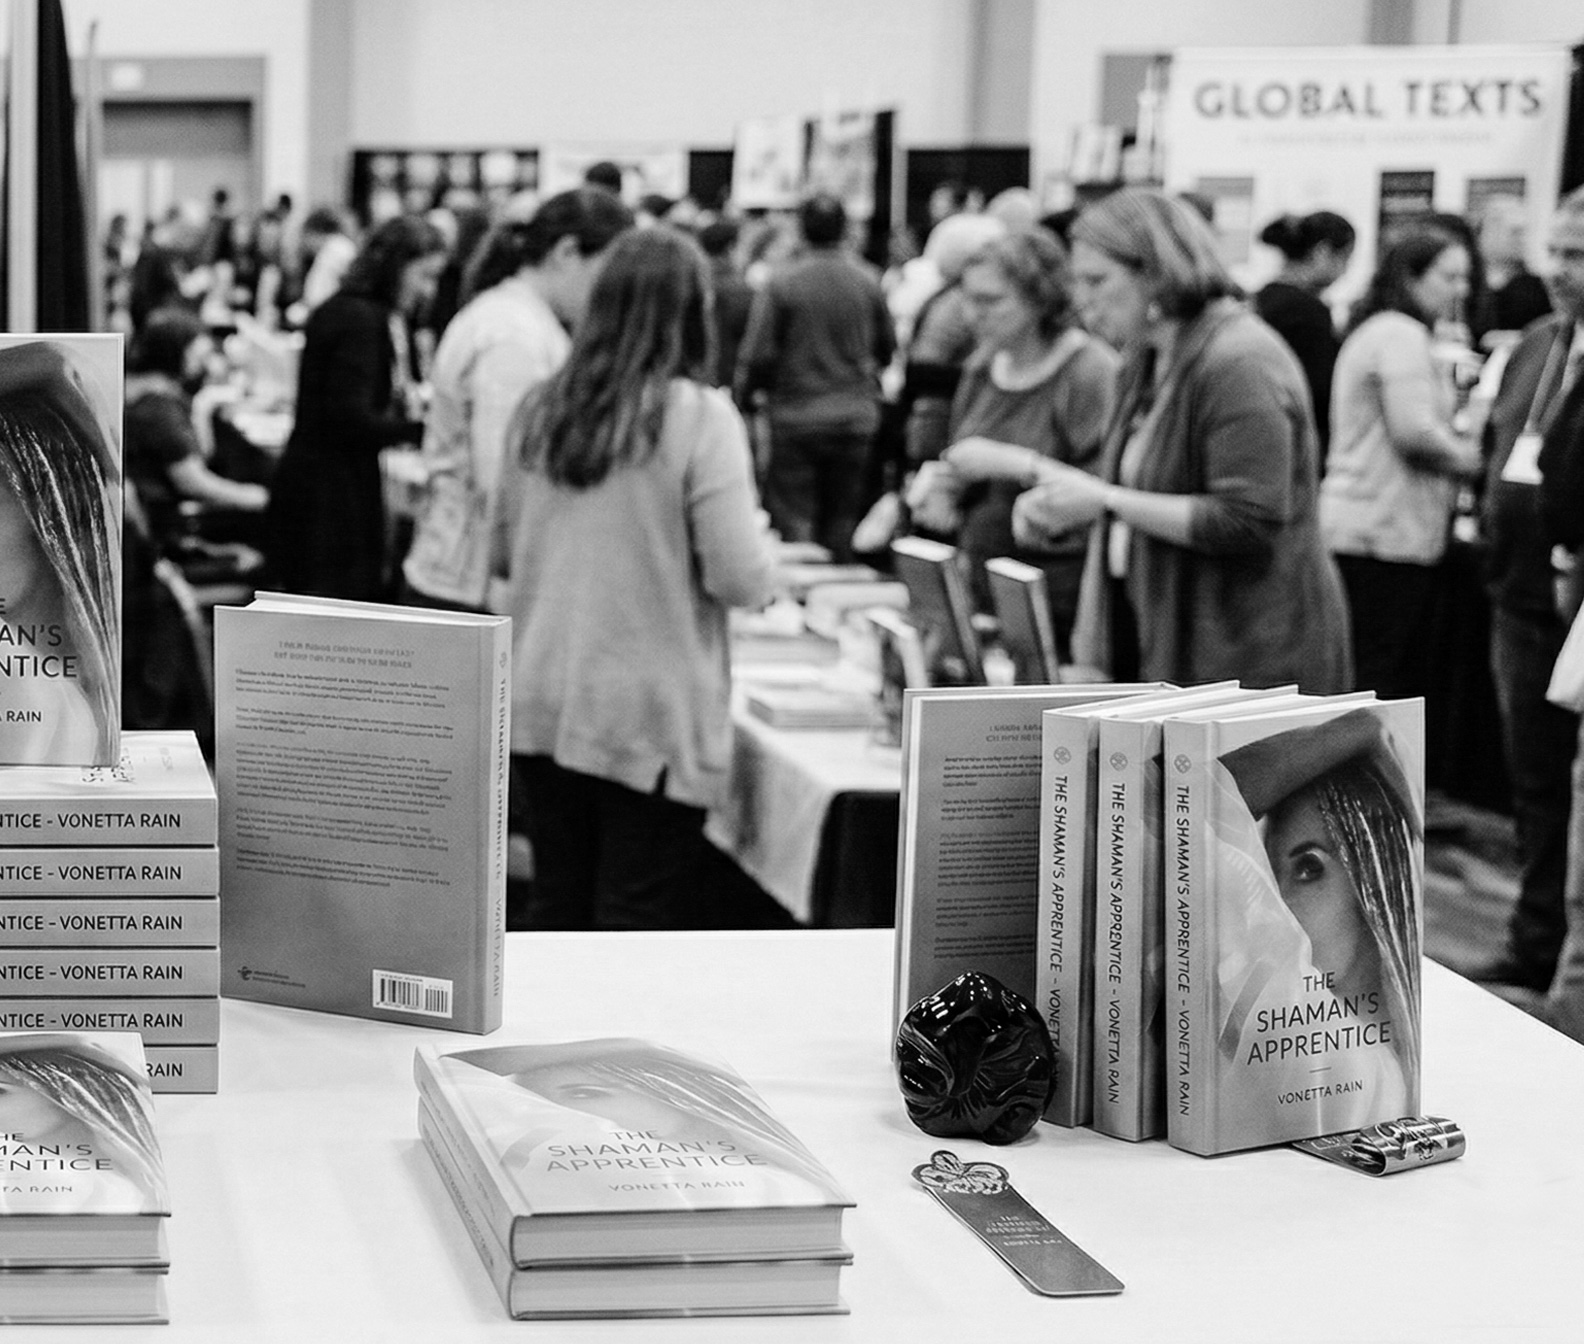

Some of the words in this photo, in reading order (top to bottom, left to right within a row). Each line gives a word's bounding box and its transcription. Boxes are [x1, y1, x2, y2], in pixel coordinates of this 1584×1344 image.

[1195, 82, 1382, 119] GLOBAL
[1406, 80, 1542, 118] TEXTS
[7, 711, 41, 722] RAIN
[1055, 776, 1068, 802] THE
[1112, 783, 1125, 810] THE
[1177, 786, 1189, 813] THE
[58, 813, 135, 828] VONETTA
[141, 813, 180, 828] RAIN
[1053, 805, 1067, 879] SHAMAN'S
[1110, 814, 1125, 891] SHAMAN'S
[1177, 818, 1190, 895] SHAMAN'S
[58, 866, 136, 880] VONETTA
[142, 866, 181, 880] RAIN
[60, 915, 140, 930] VONETTA
[143, 915, 182, 930] RAIN
[1050, 883, 1065, 973] APPRENTICE
[1177, 898, 1190, 993] APPRENTICE
[60, 965, 138, 980] VONETTA
[143, 965, 182, 980] RAIN
[1303, 972, 1336, 992] THE
[59, 1013, 138, 1030] VONETTA
[143, 1013, 182, 1028] RAIN
[1257, 992, 1379, 1032] SHAMAN'S
[1108, 1000, 1120, 1064] VONETTA
[1179, 1010, 1190, 1076] VONETTA
[1247, 1021, 1391, 1066] APPRENTICE
[146, 1063, 182, 1077] RAIN
[1107, 1069, 1119, 1103] RAIN
[1179, 1081, 1190, 1115] RAIN
[1278, 1086, 1332, 1104] VONETTA
[1336, 1080, 1363, 1094] RAIN
[609, 1130, 659, 1140] THE
[548, 1140, 736, 1157] SHAMAN'S
[547, 1154, 768, 1172] APPRENTICE
[608, 1182, 696, 1192] VONETTA
[701, 1180, 745, 1188] RAIN
